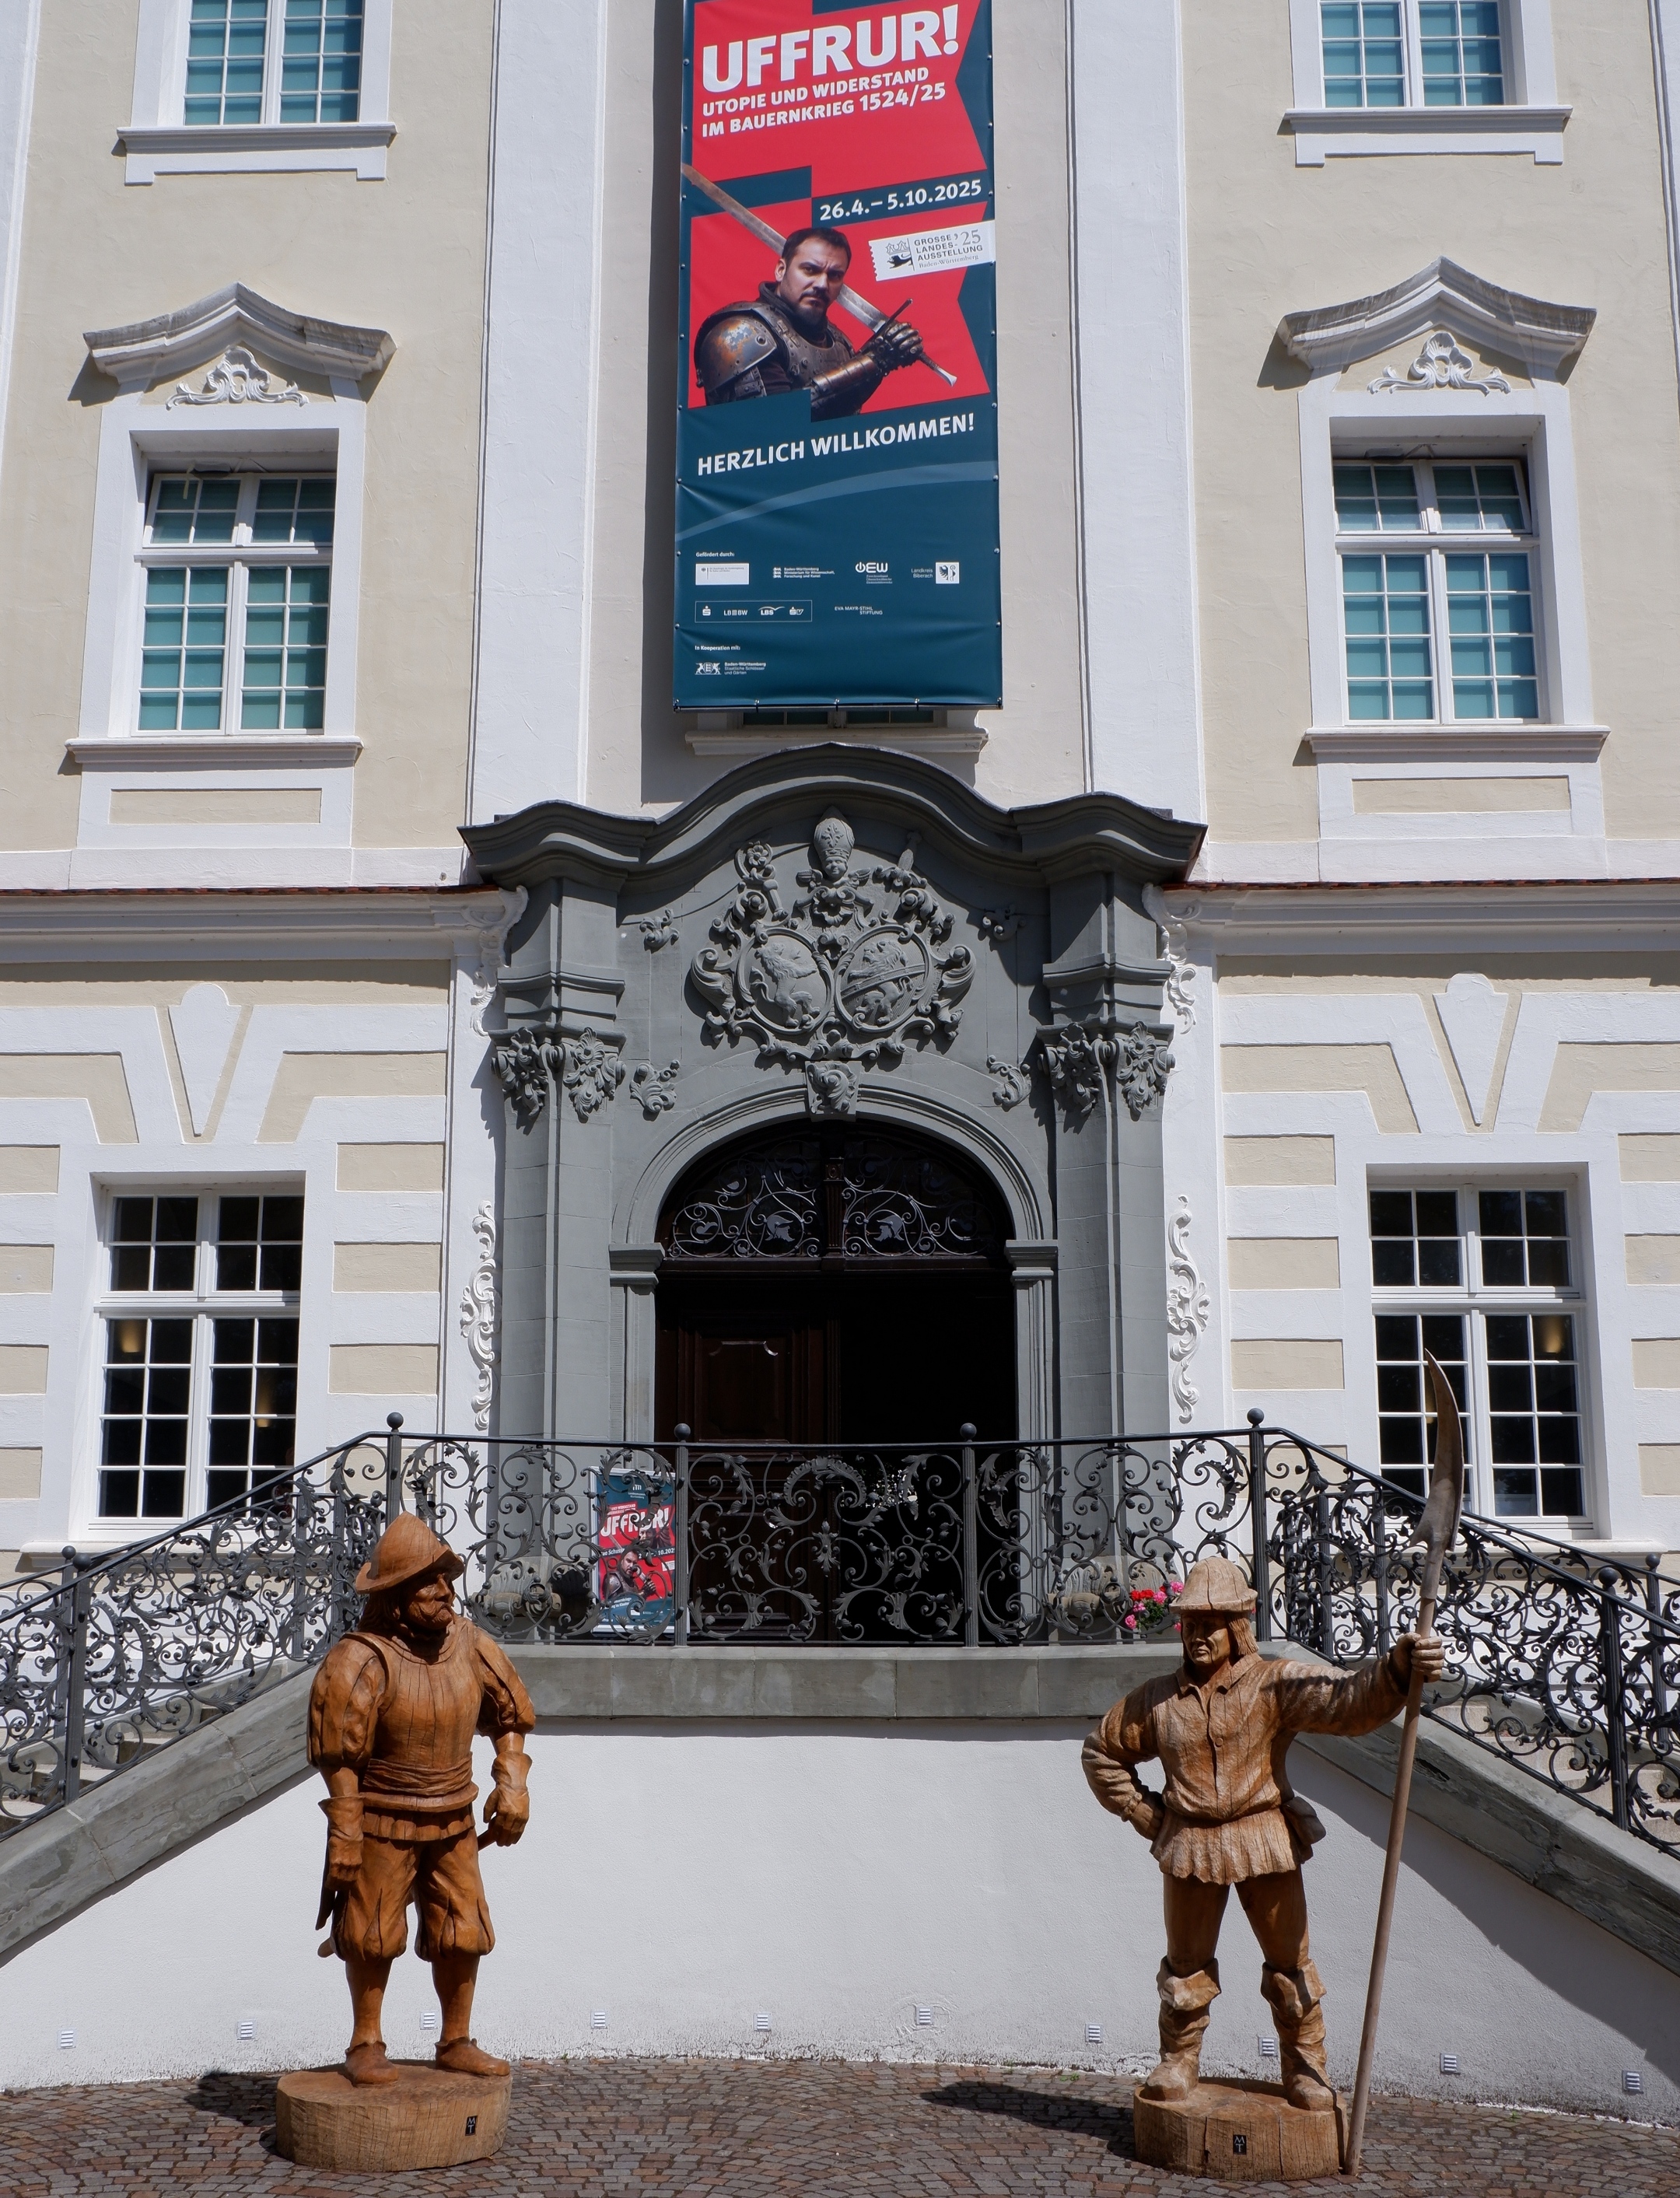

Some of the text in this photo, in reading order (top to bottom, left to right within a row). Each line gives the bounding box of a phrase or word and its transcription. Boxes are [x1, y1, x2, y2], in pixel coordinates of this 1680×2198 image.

[702, 3, 959, 93] UFFRUR!
[702, 66, 929, 117] UTOPIE UND WIDERSTAND
[702, 82, 947, 138] IM BAUERNKRIEG 1524/25
[887, 179, 982, 209] 5.10.2025
[914, 234, 951, 247] GROSSE
[915, 241, 958, 254] LANDES-
[917, 244, 983, 262] AUSSTELLUNG
[919, 254, 979, 269] Baden-Württemberg
[697, 412, 975, 476] HERZLICH WILLKOMMEN!
